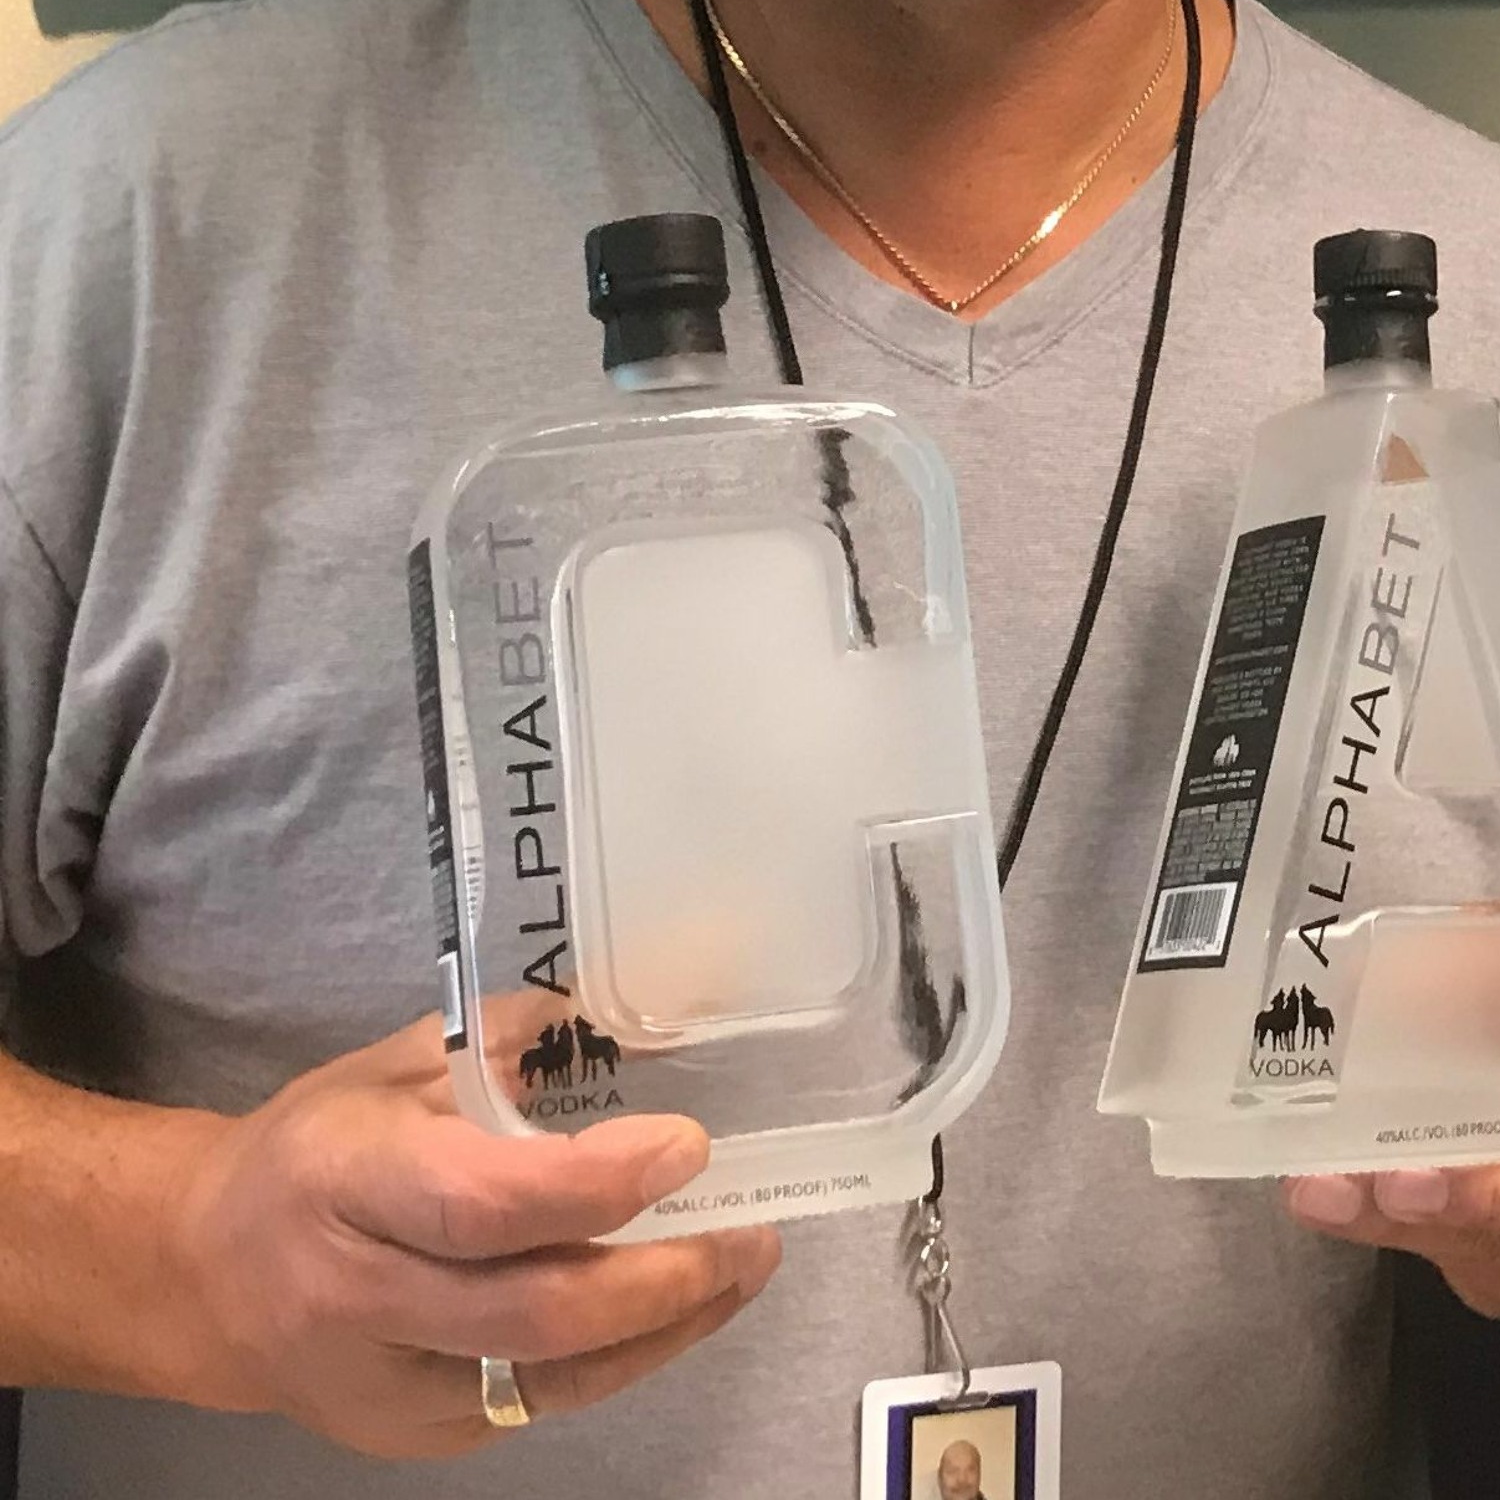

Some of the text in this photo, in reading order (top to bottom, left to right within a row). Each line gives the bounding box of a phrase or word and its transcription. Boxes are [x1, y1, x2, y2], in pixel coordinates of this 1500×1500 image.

[1298, 513, 1421, 968] ALPHABET
[487, 520, 571, 998] ALPHABET
[1249, 1057, 1335, 1078] VODKA
[515, 1089, 624, 1122] VODKA
[830, 1174, 872, 1191] 750ML
